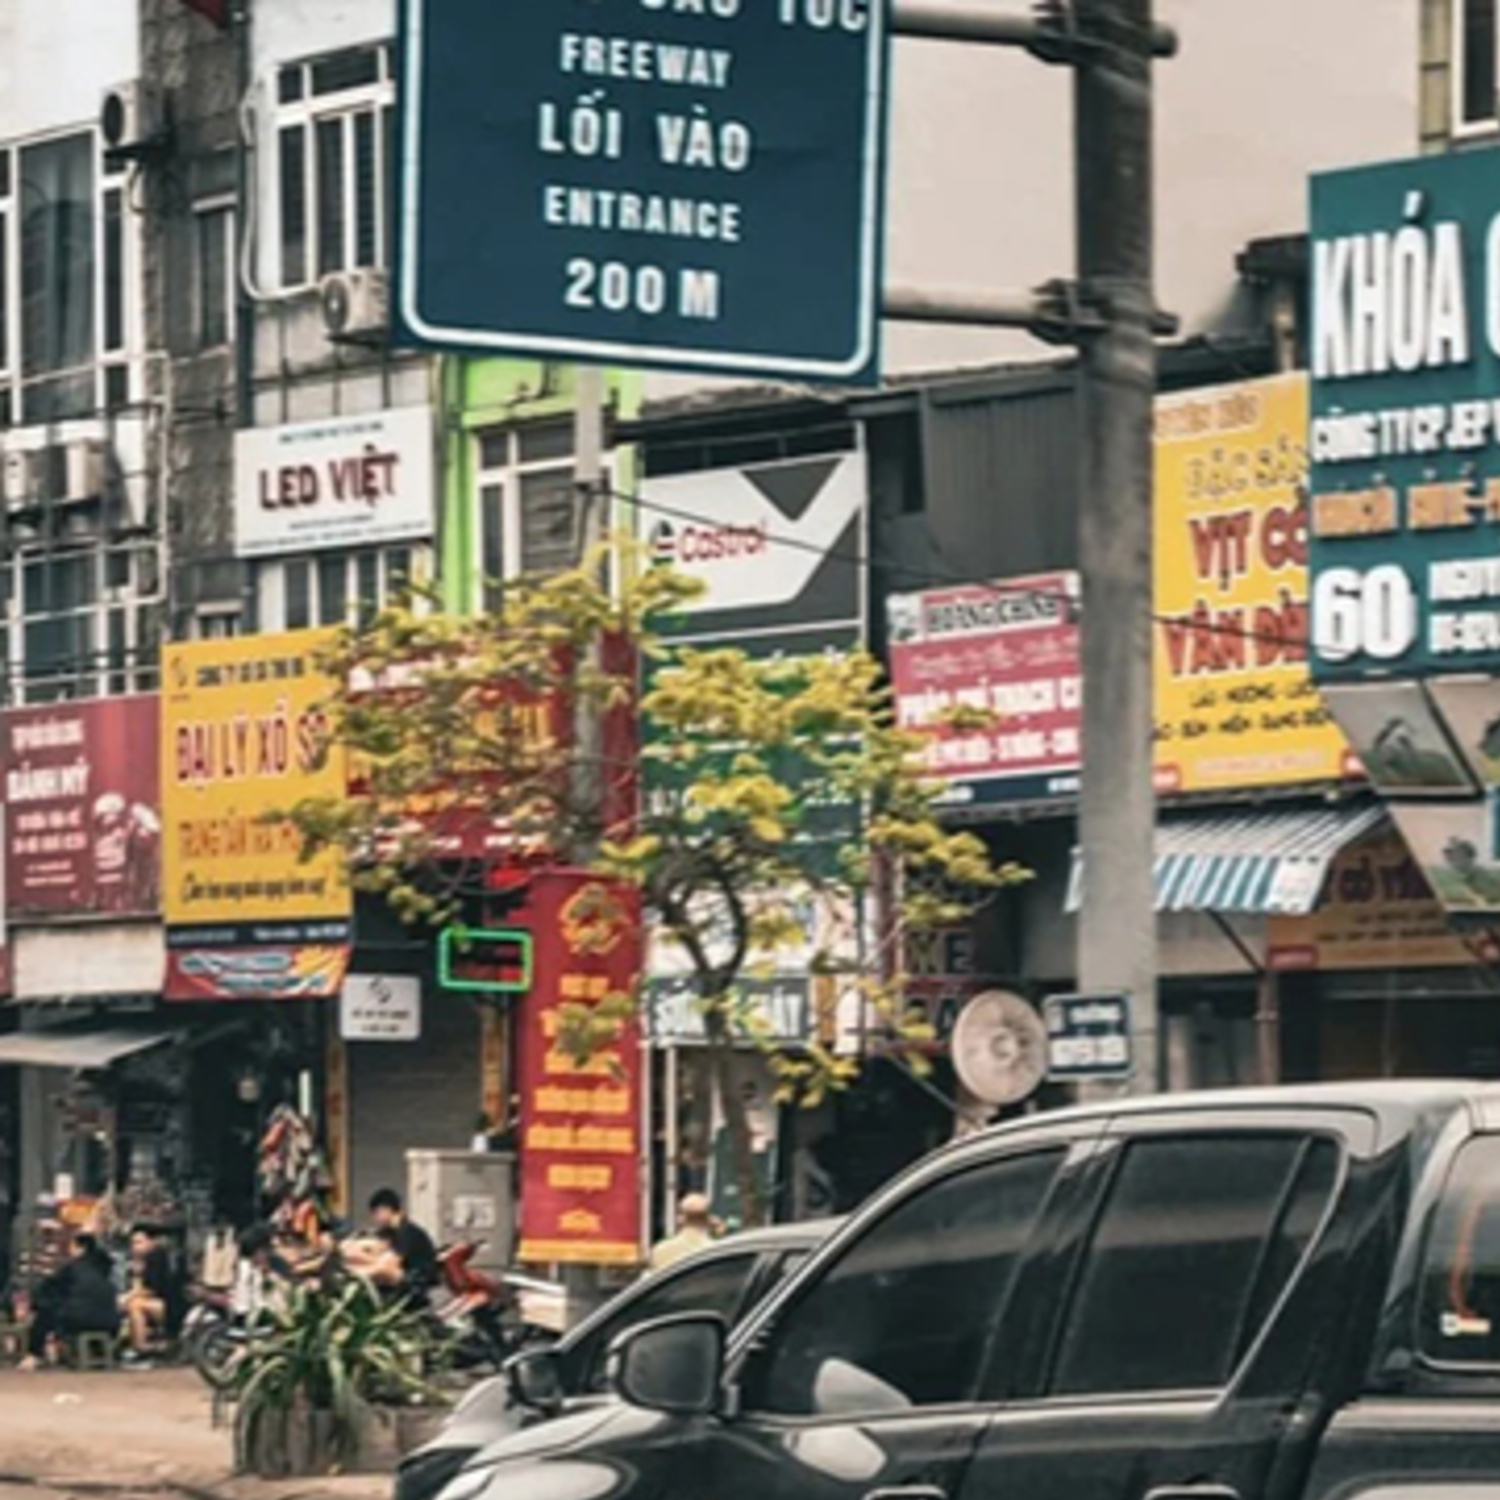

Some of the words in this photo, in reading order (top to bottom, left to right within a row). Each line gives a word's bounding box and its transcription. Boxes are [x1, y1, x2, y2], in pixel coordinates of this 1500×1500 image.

[560, 34, 731, 87] FREEWAY
[539, 90, 622, 159] LỐI
[656, 104, 751, 171] VÀO
[544, 185, 741, 242] ENTRANCE
[564, 257, 666, 315] 200
[679, 269, 720, 320] M
[1313, 190, 1469, 379] KHÓA
[258, 464, 320, 511] LED
[328, 442, 400, 508] VIỆT
[678, 517, 769, 563] Castrol
[1312, 564, 1418, 662] 60
